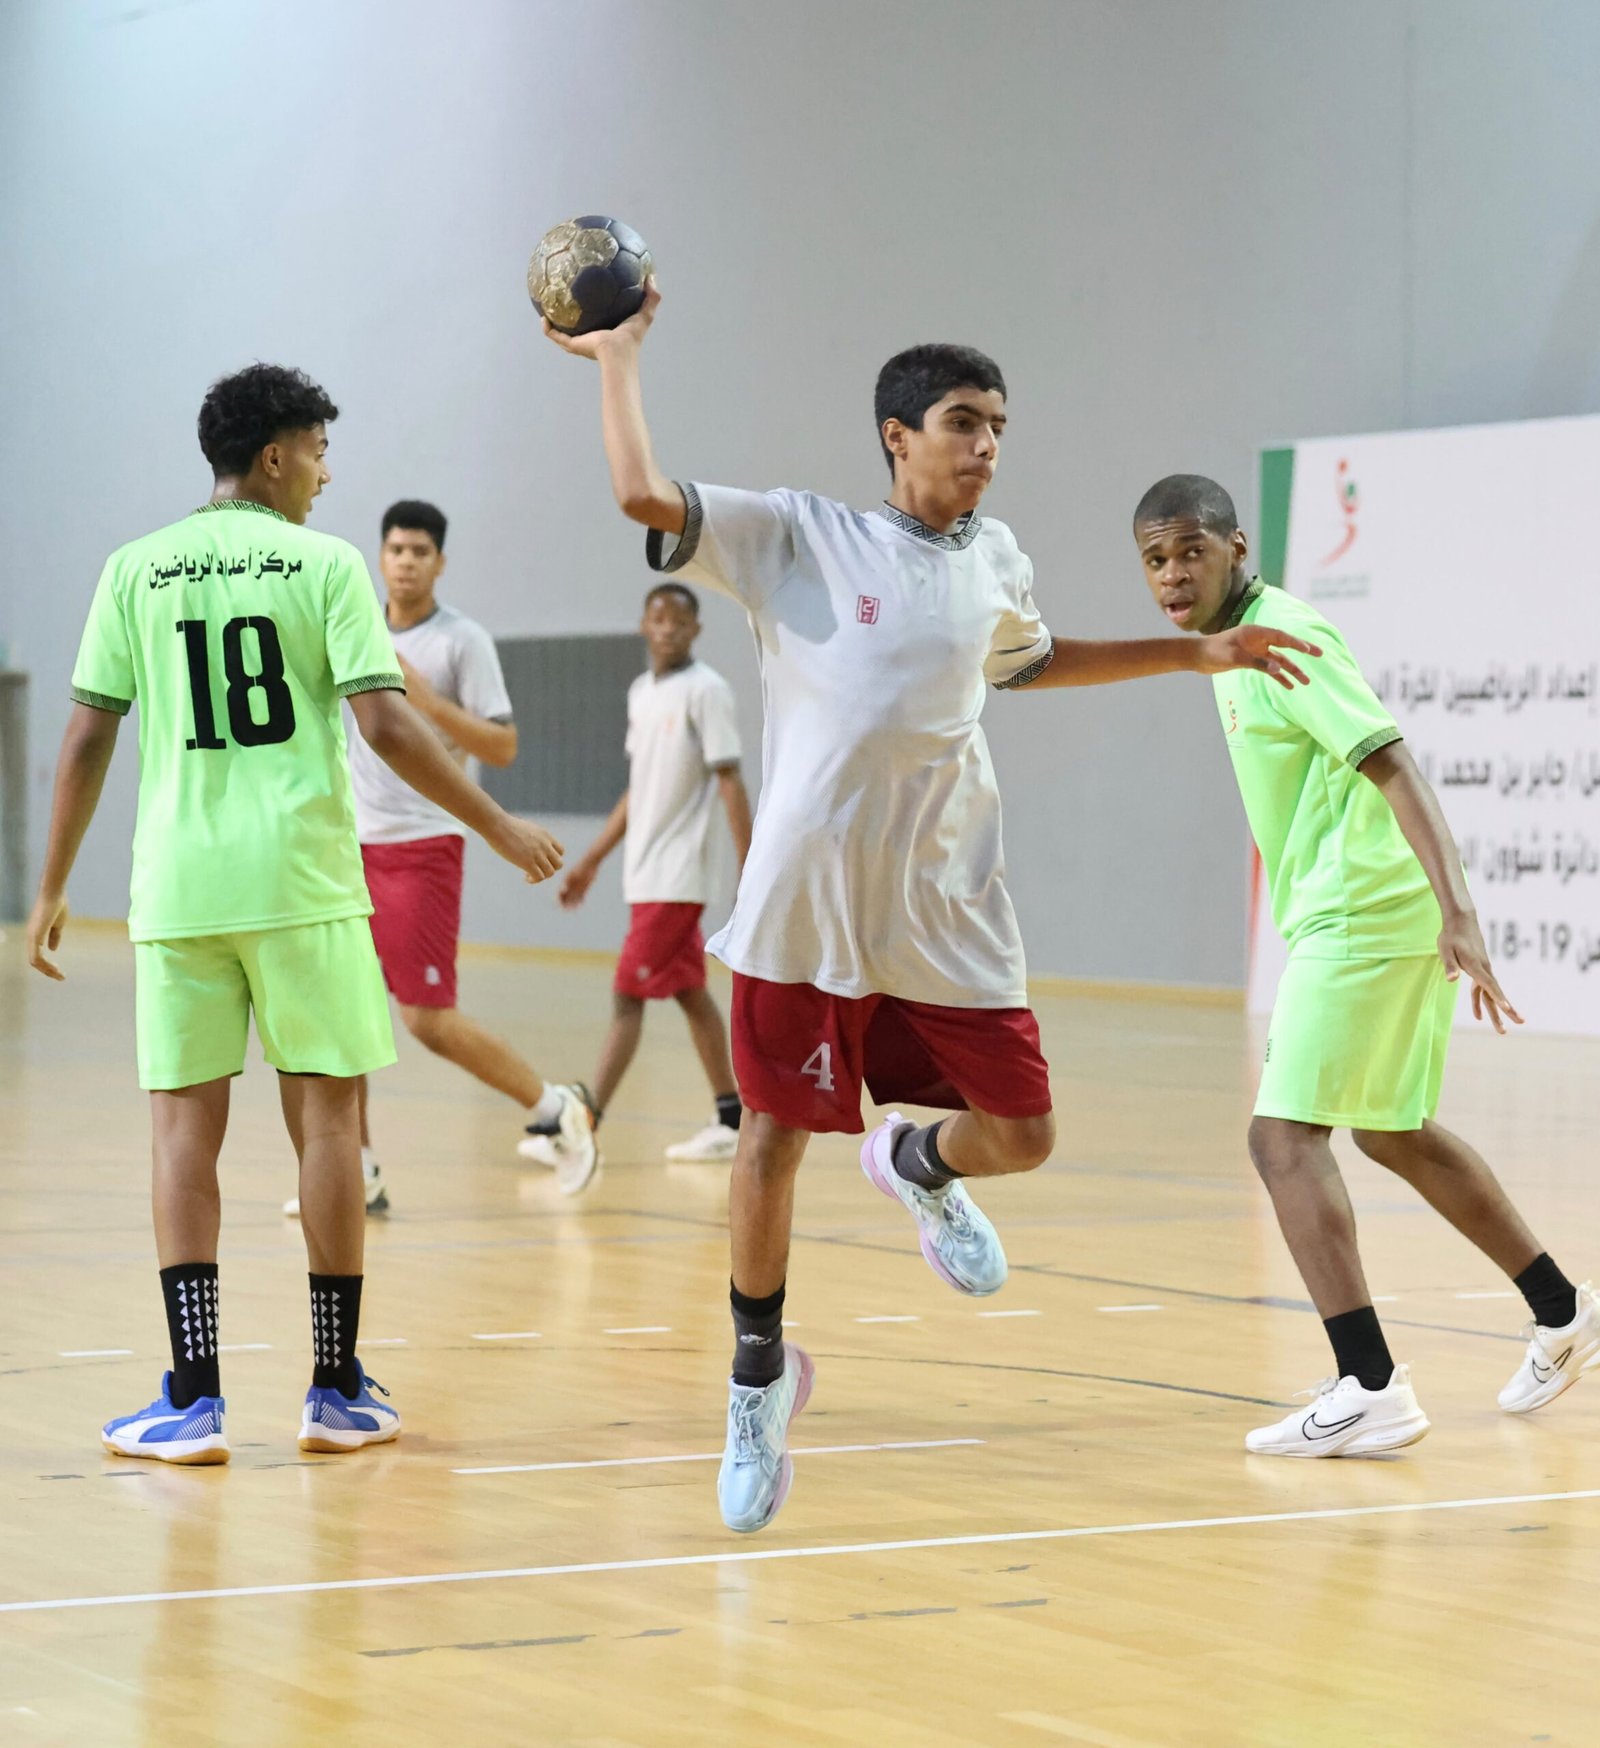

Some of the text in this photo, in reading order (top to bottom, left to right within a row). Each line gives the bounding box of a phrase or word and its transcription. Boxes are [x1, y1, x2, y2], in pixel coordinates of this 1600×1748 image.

[149, 551, 214, 589] الرياضيين
[254, 550, 302, 580] مركز
[175, 615, 296, 750] 18
[1400, 661, 1440, 715] لكرة
[1444, 662, 1543, 716] الرياضيين
[1442, 757, 1490, 787] محمد
[1498, 750, 1519, 799] بن
[1526, 751, 1566, 799] جابر
[1482, 827, 1543, 885] شؤون
[1488, 918, 1572, 962] 18-19
[801, 1041, 835, 1091] 4
